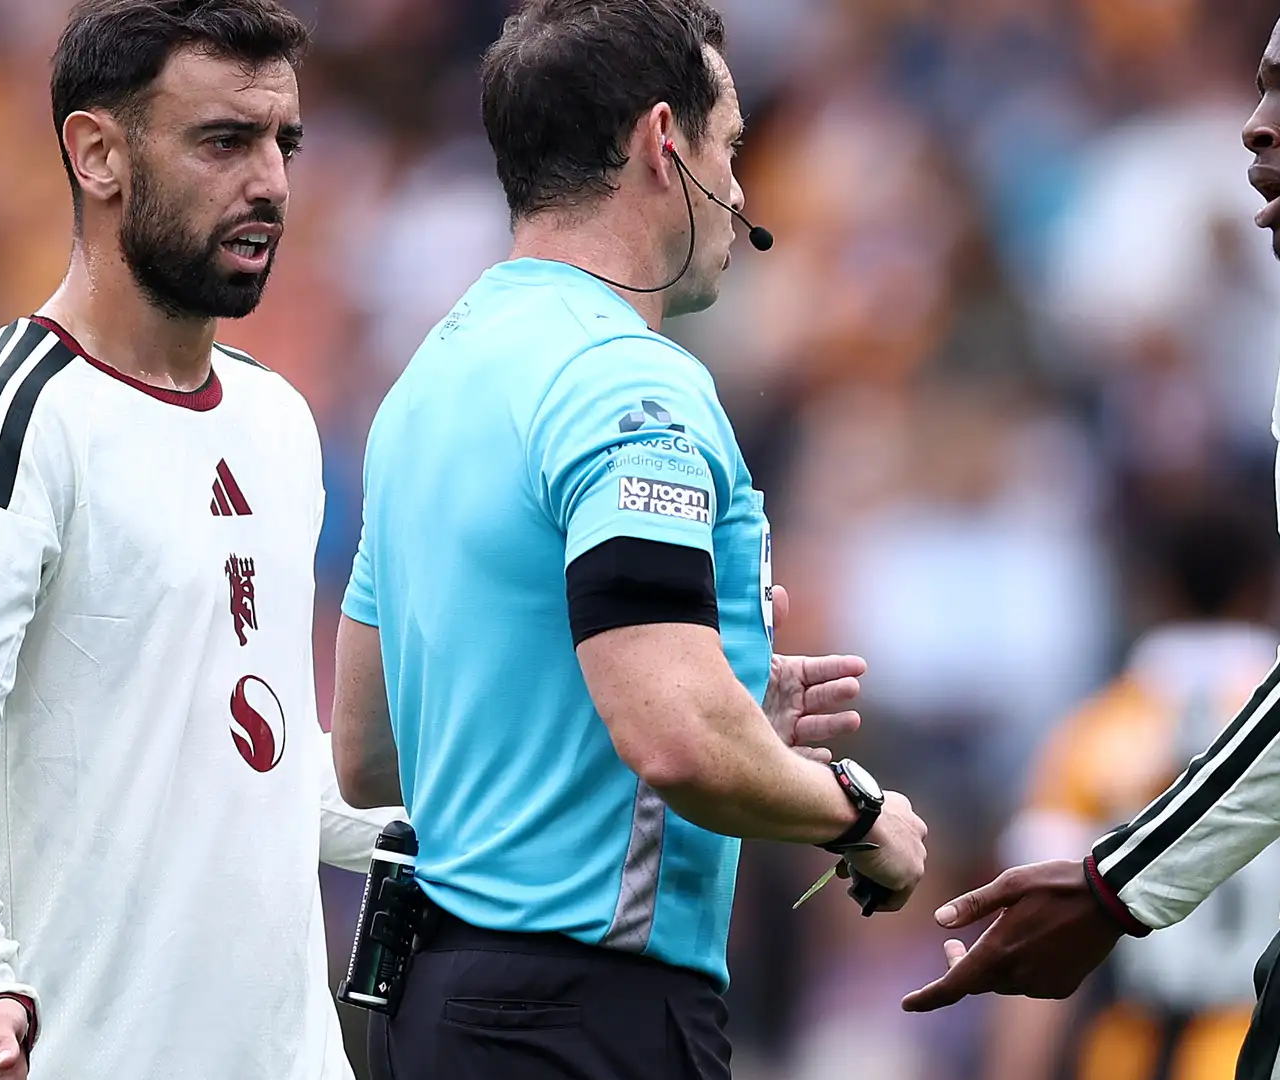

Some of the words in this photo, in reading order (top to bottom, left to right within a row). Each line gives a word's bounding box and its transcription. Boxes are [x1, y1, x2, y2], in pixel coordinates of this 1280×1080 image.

[606, 455, 663, 474] Building
[620, 477, 651, 498] No
[653, 484, 706, 507] room
[619, 491, 650, 511] for
[649, 498, 710, 524] racism
